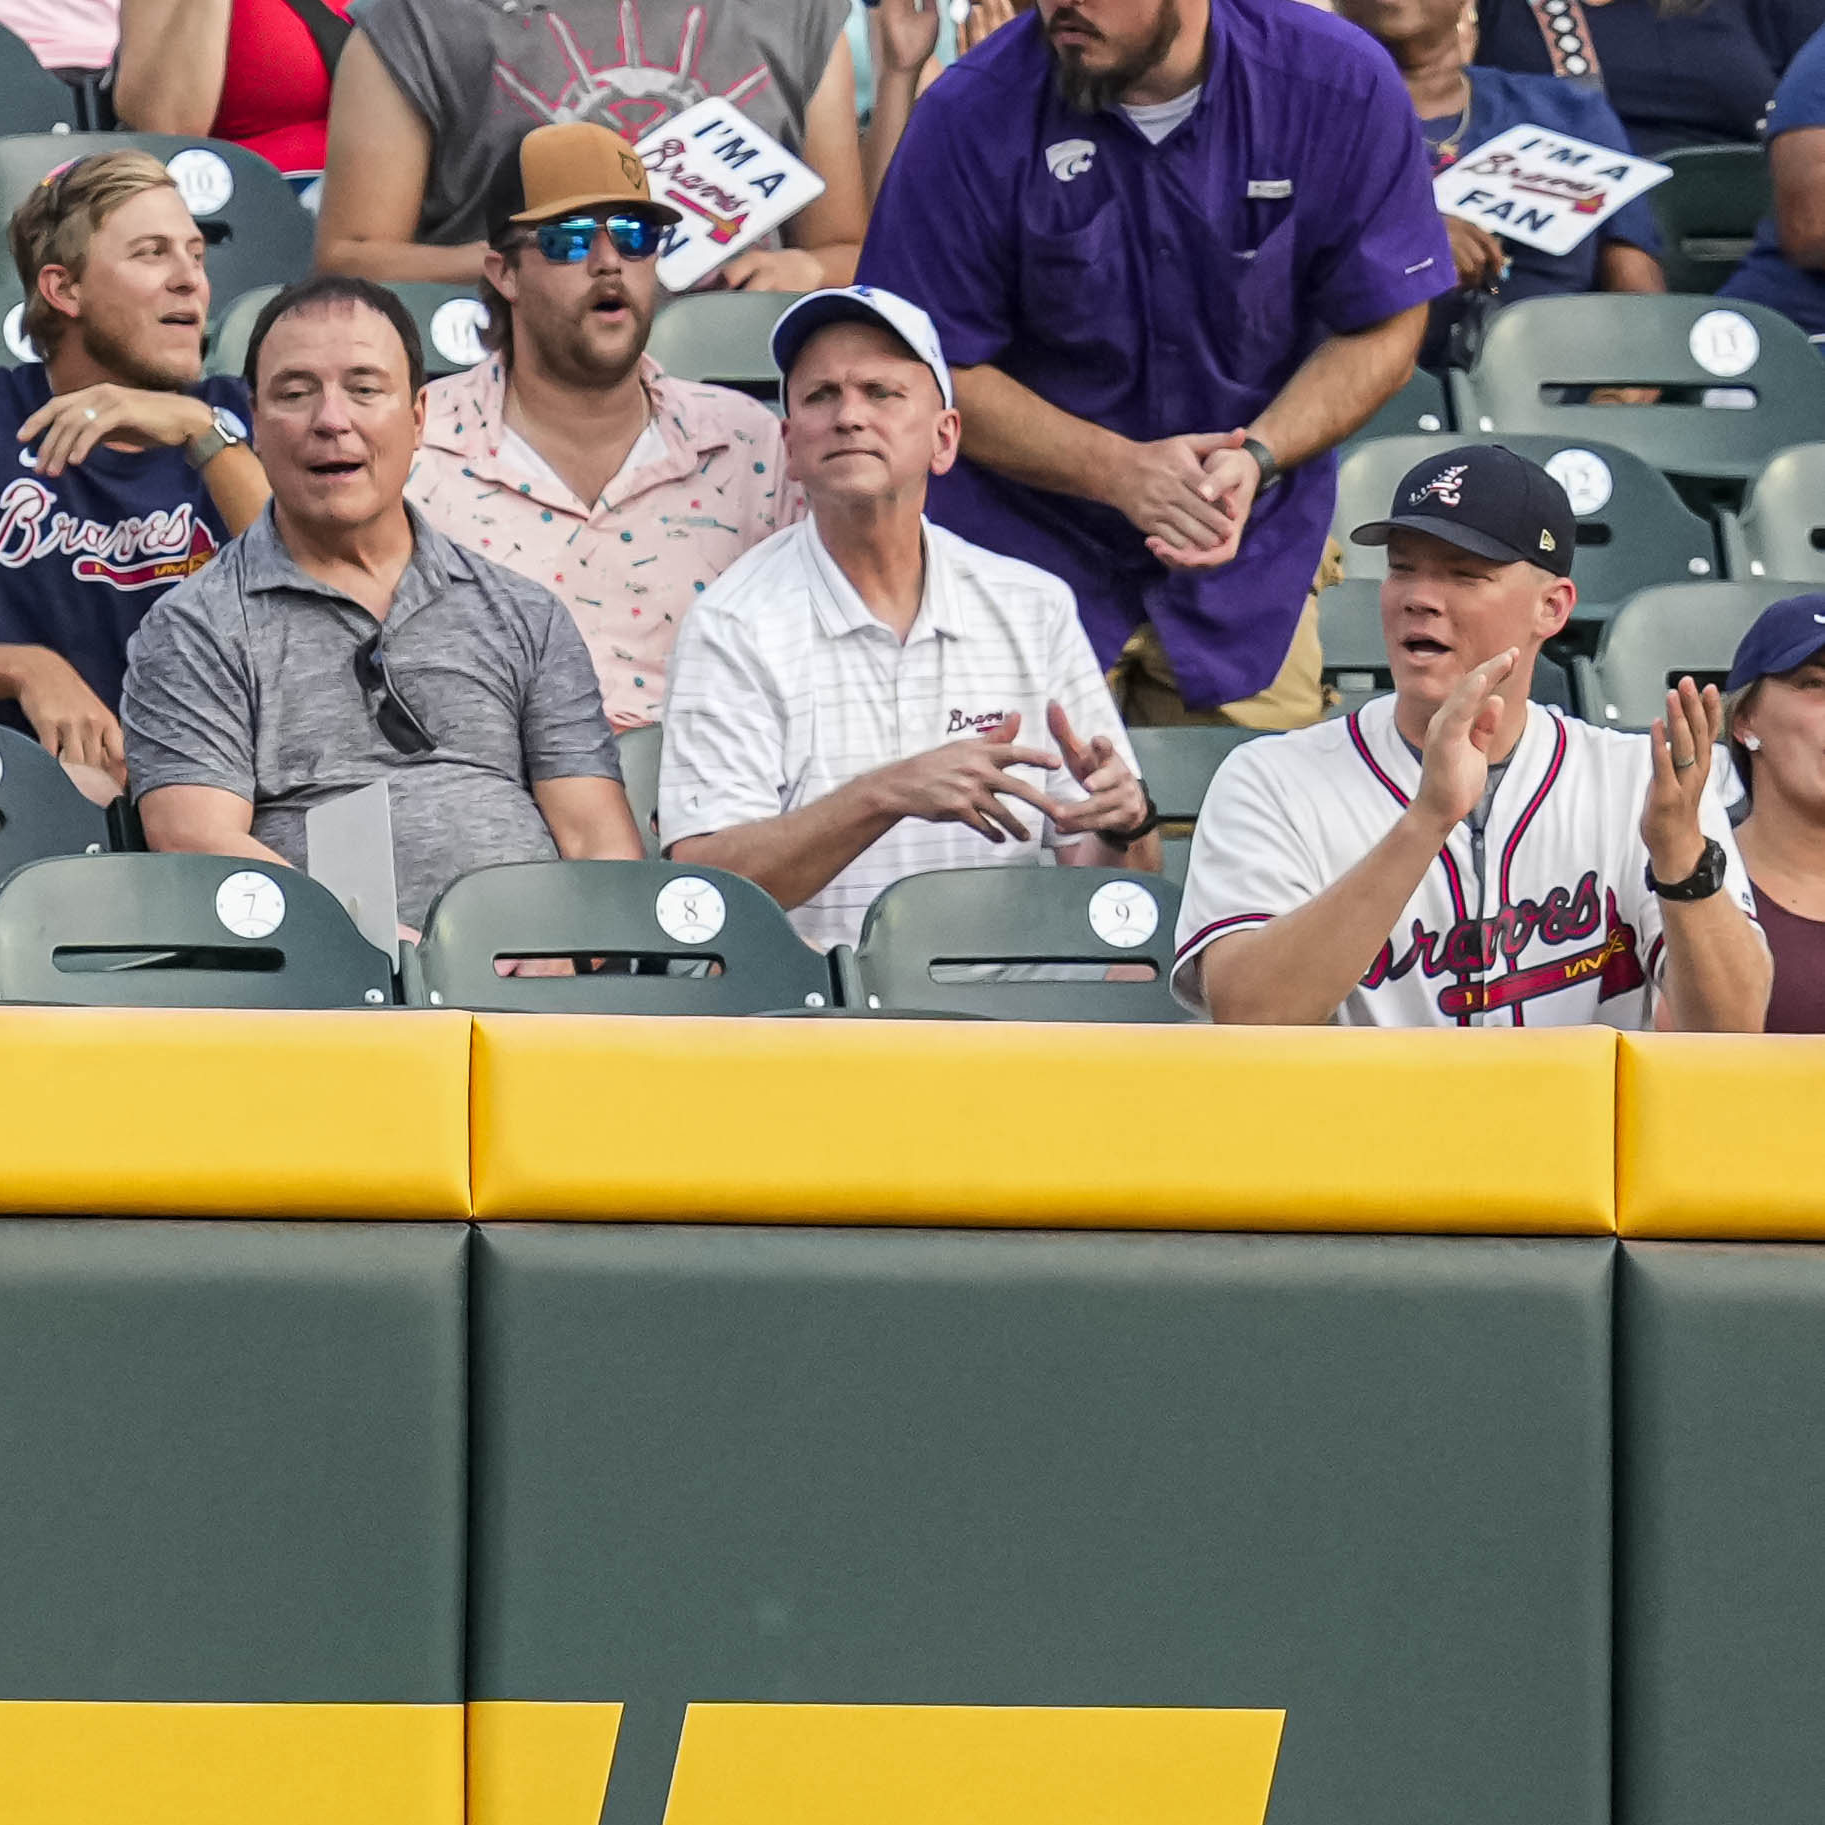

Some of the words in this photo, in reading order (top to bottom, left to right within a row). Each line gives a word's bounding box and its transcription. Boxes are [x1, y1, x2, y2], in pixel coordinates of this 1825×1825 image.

[693, 120, 760, 170] I'M
[749, 172, 786, 198] A
[1519, 138, 1592, 167] I'M
[1596, 164, 1631, 182] A
[1456, 189, 1555, 232] FAN
[240, 892, 256, 921] 7
[681, 899, 699, 924] 8
[1114, 898, 1129, 922] 9
[1360, 870, 1601, 980] raves
